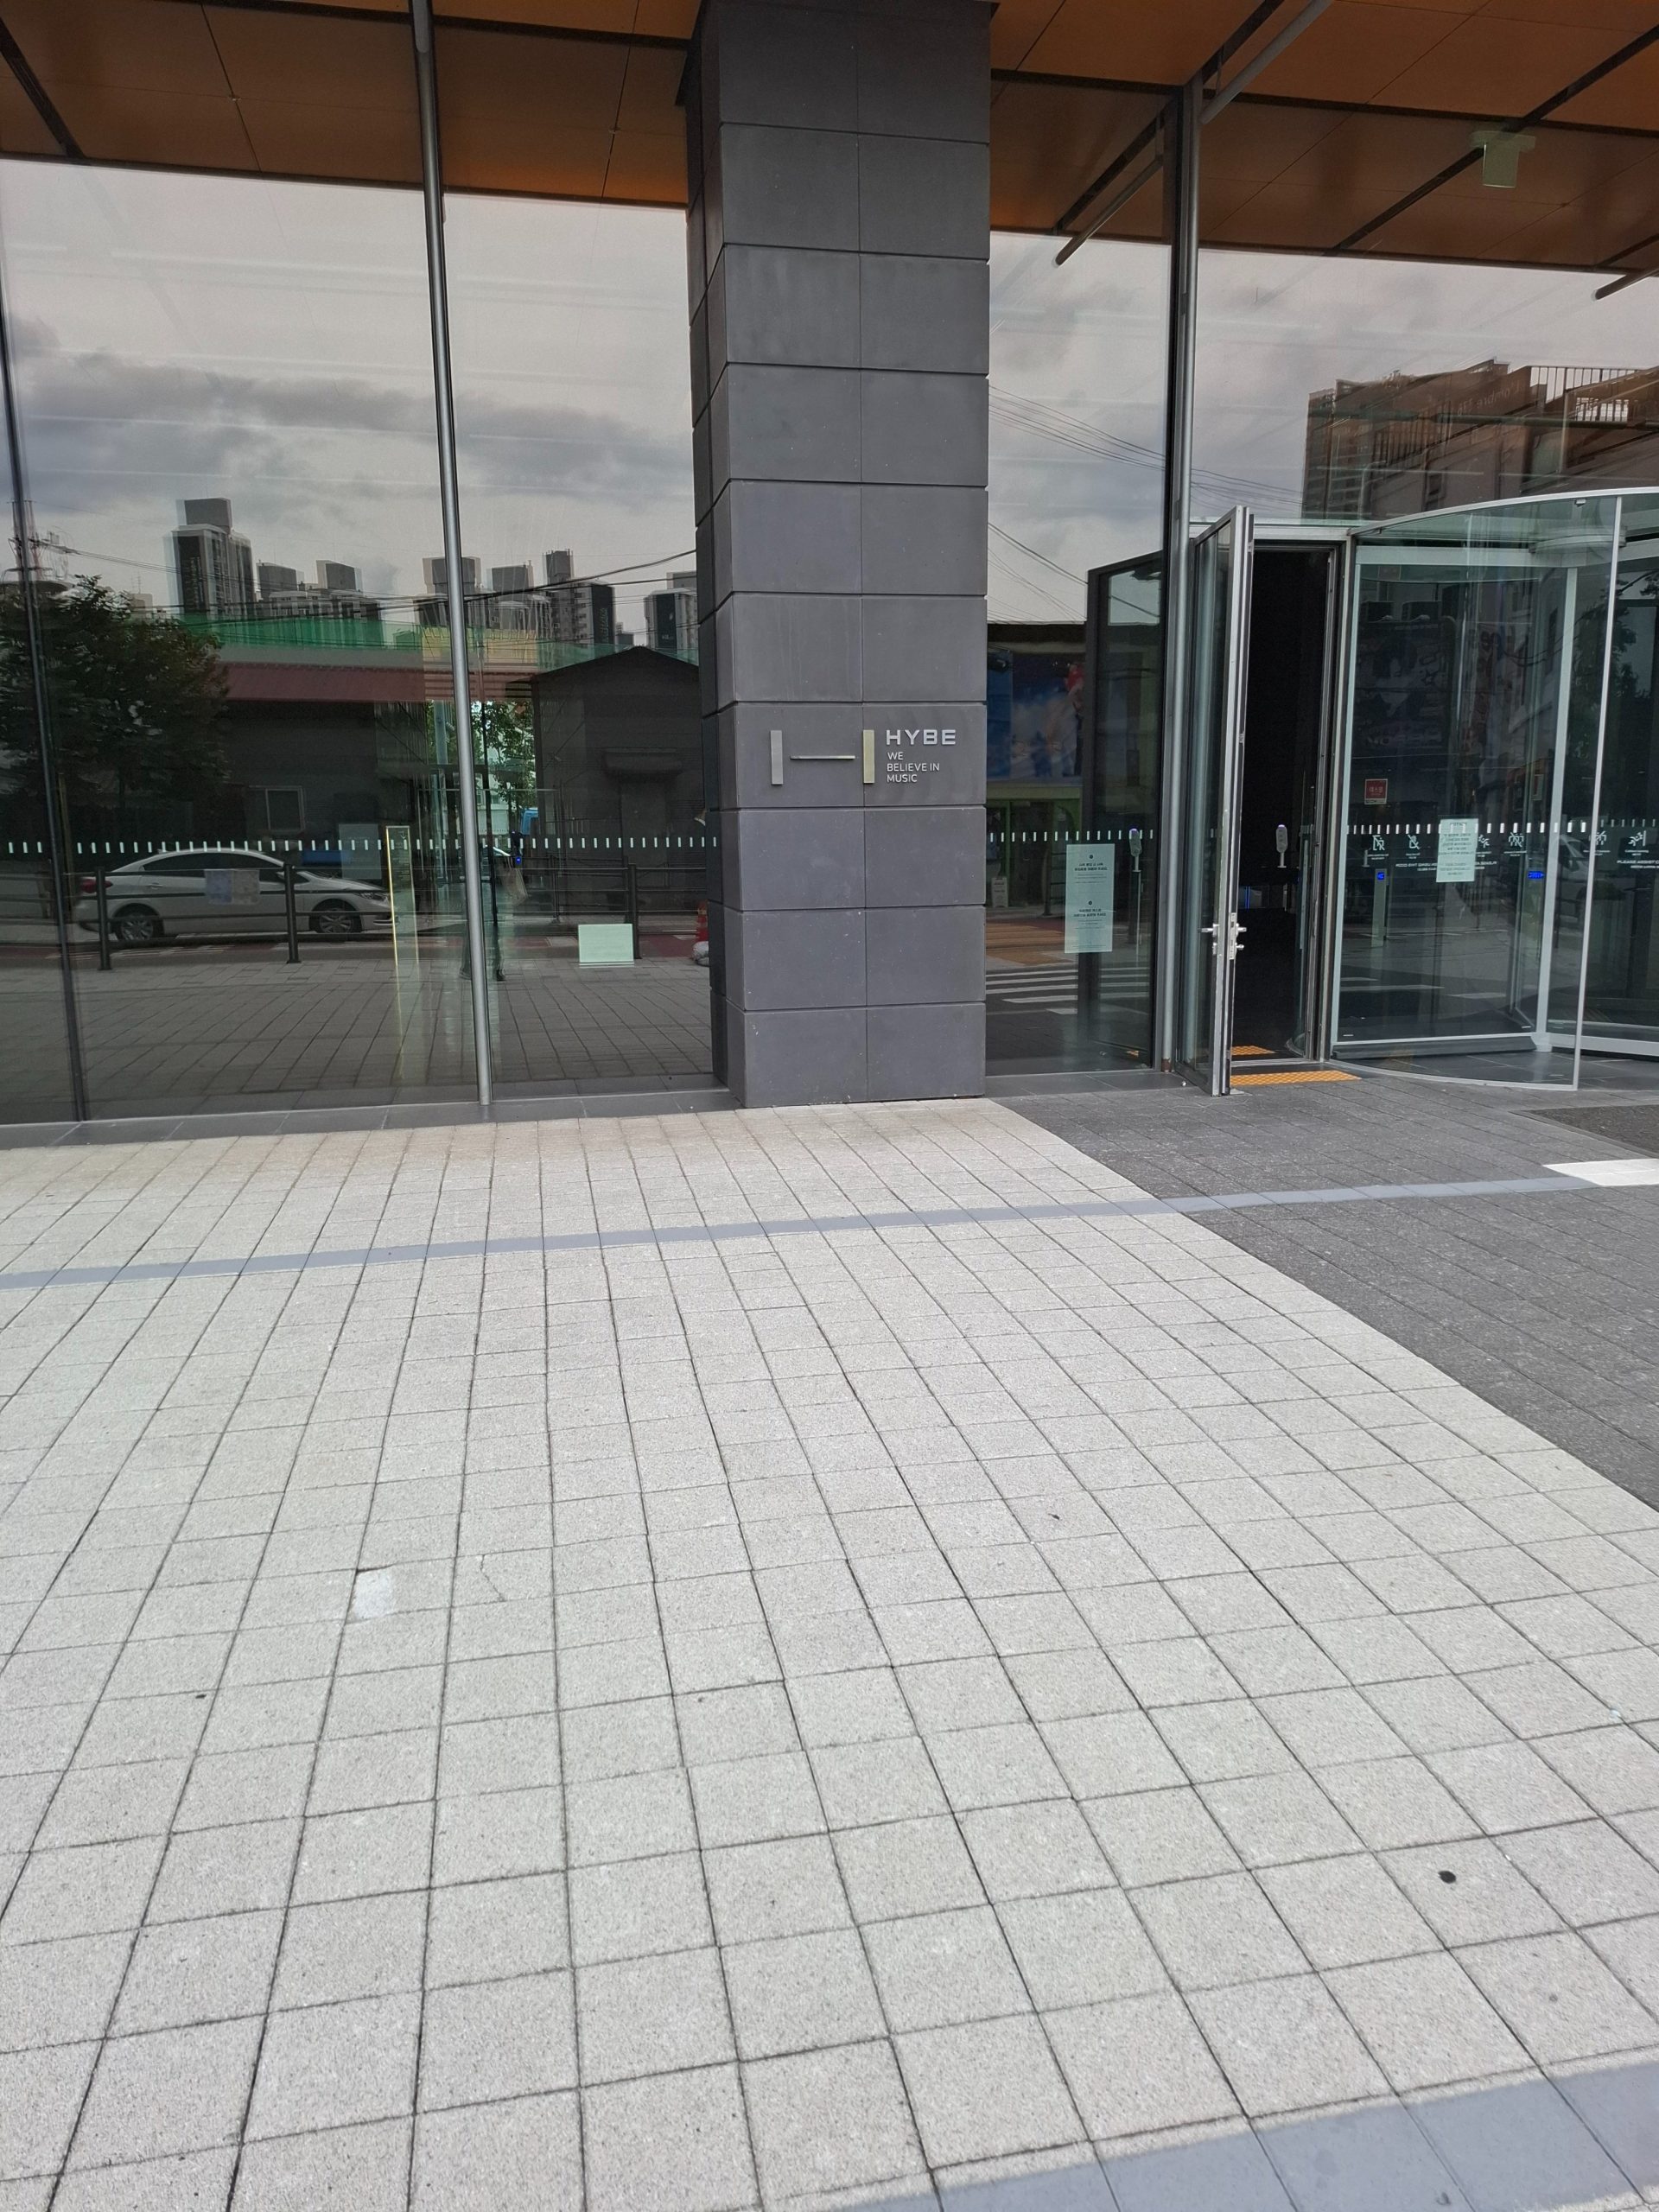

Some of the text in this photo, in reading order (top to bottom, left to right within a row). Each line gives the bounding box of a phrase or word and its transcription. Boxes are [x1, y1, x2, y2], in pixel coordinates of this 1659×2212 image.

[886, 728, 956, 746] HYBE
[887, 752, 904, 760] WE
[887, 762, 940, 772] BELIEVE IN
[887, 774, 918, 783] MUSIC
